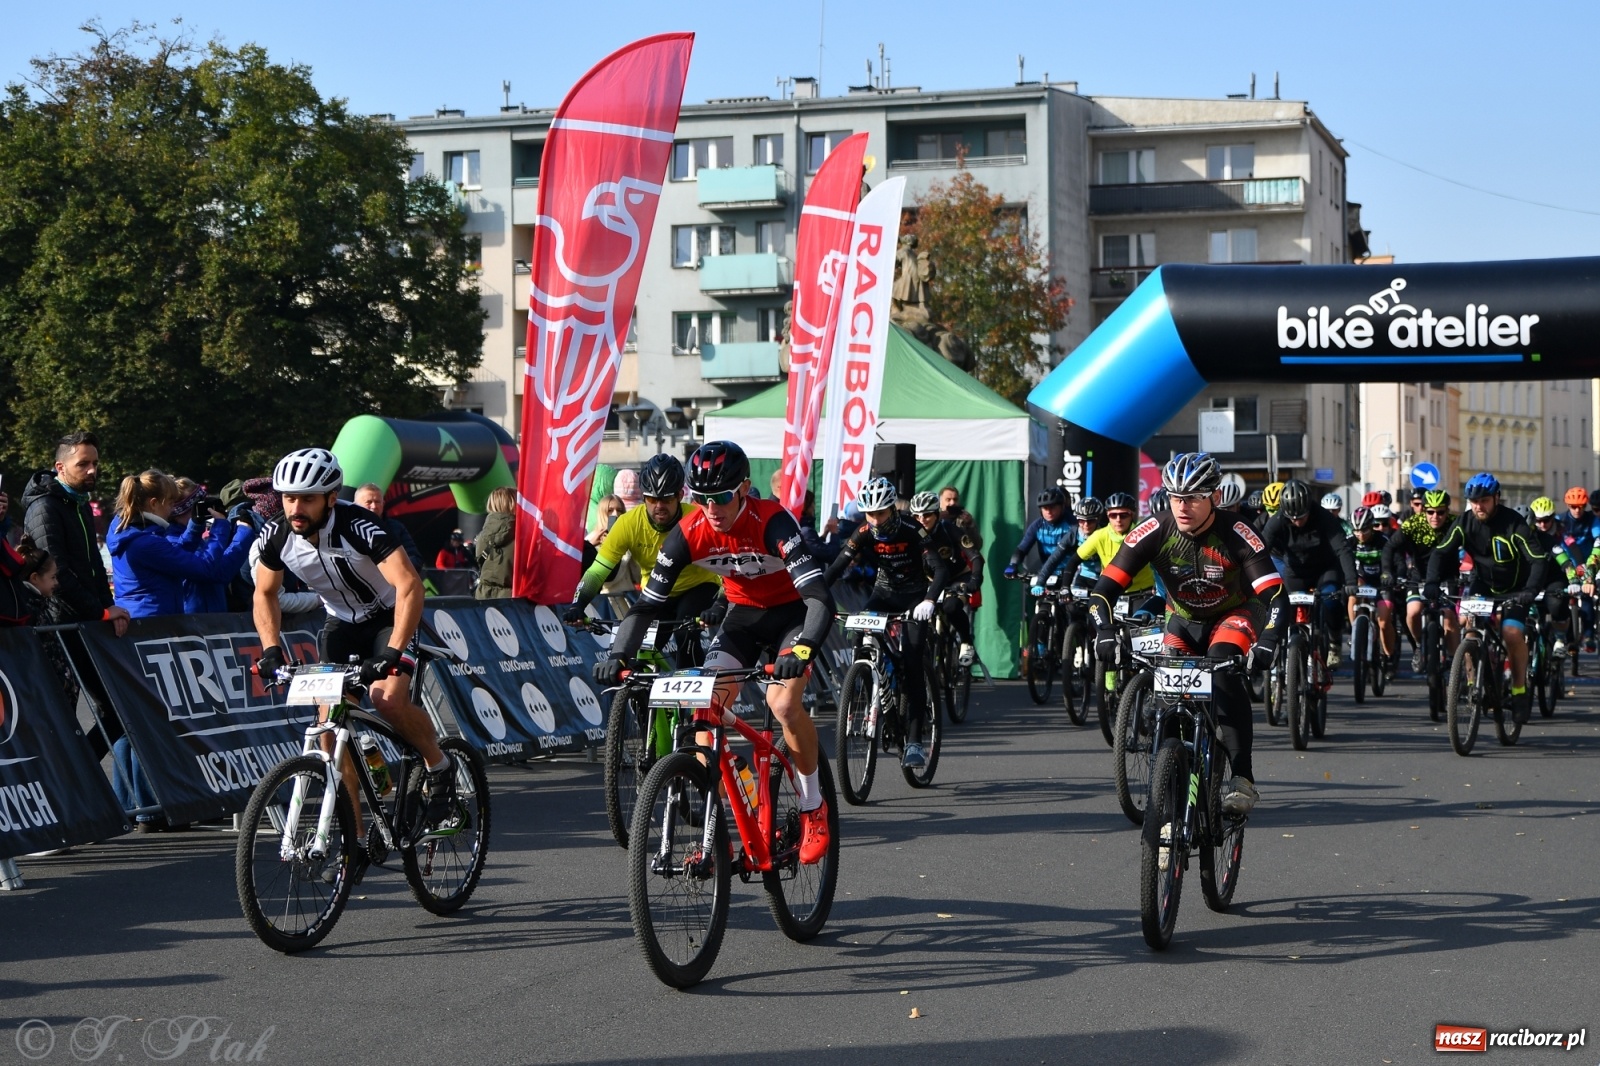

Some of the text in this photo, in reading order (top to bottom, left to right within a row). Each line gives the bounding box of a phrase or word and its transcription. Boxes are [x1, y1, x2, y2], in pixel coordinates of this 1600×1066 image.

[1278, 303, 1540, 348] bike atelier
[704, 553, 766, 566] TREK
[853, 617, 880, 627] 3290
[498, 660, 536, 673] KOKOwear
[547, 655, 584, 668] KOKOwear
[447, 662, 486, 677] KOKOwear
[297, 677, 334, 692] 2676
[661, 680, 704, 694] 1472
[1163, 674, 1203, 688] 1236
[537, 734, 573, 749] KOKOwear
[485, 742, 523, 757] KOKOwear
